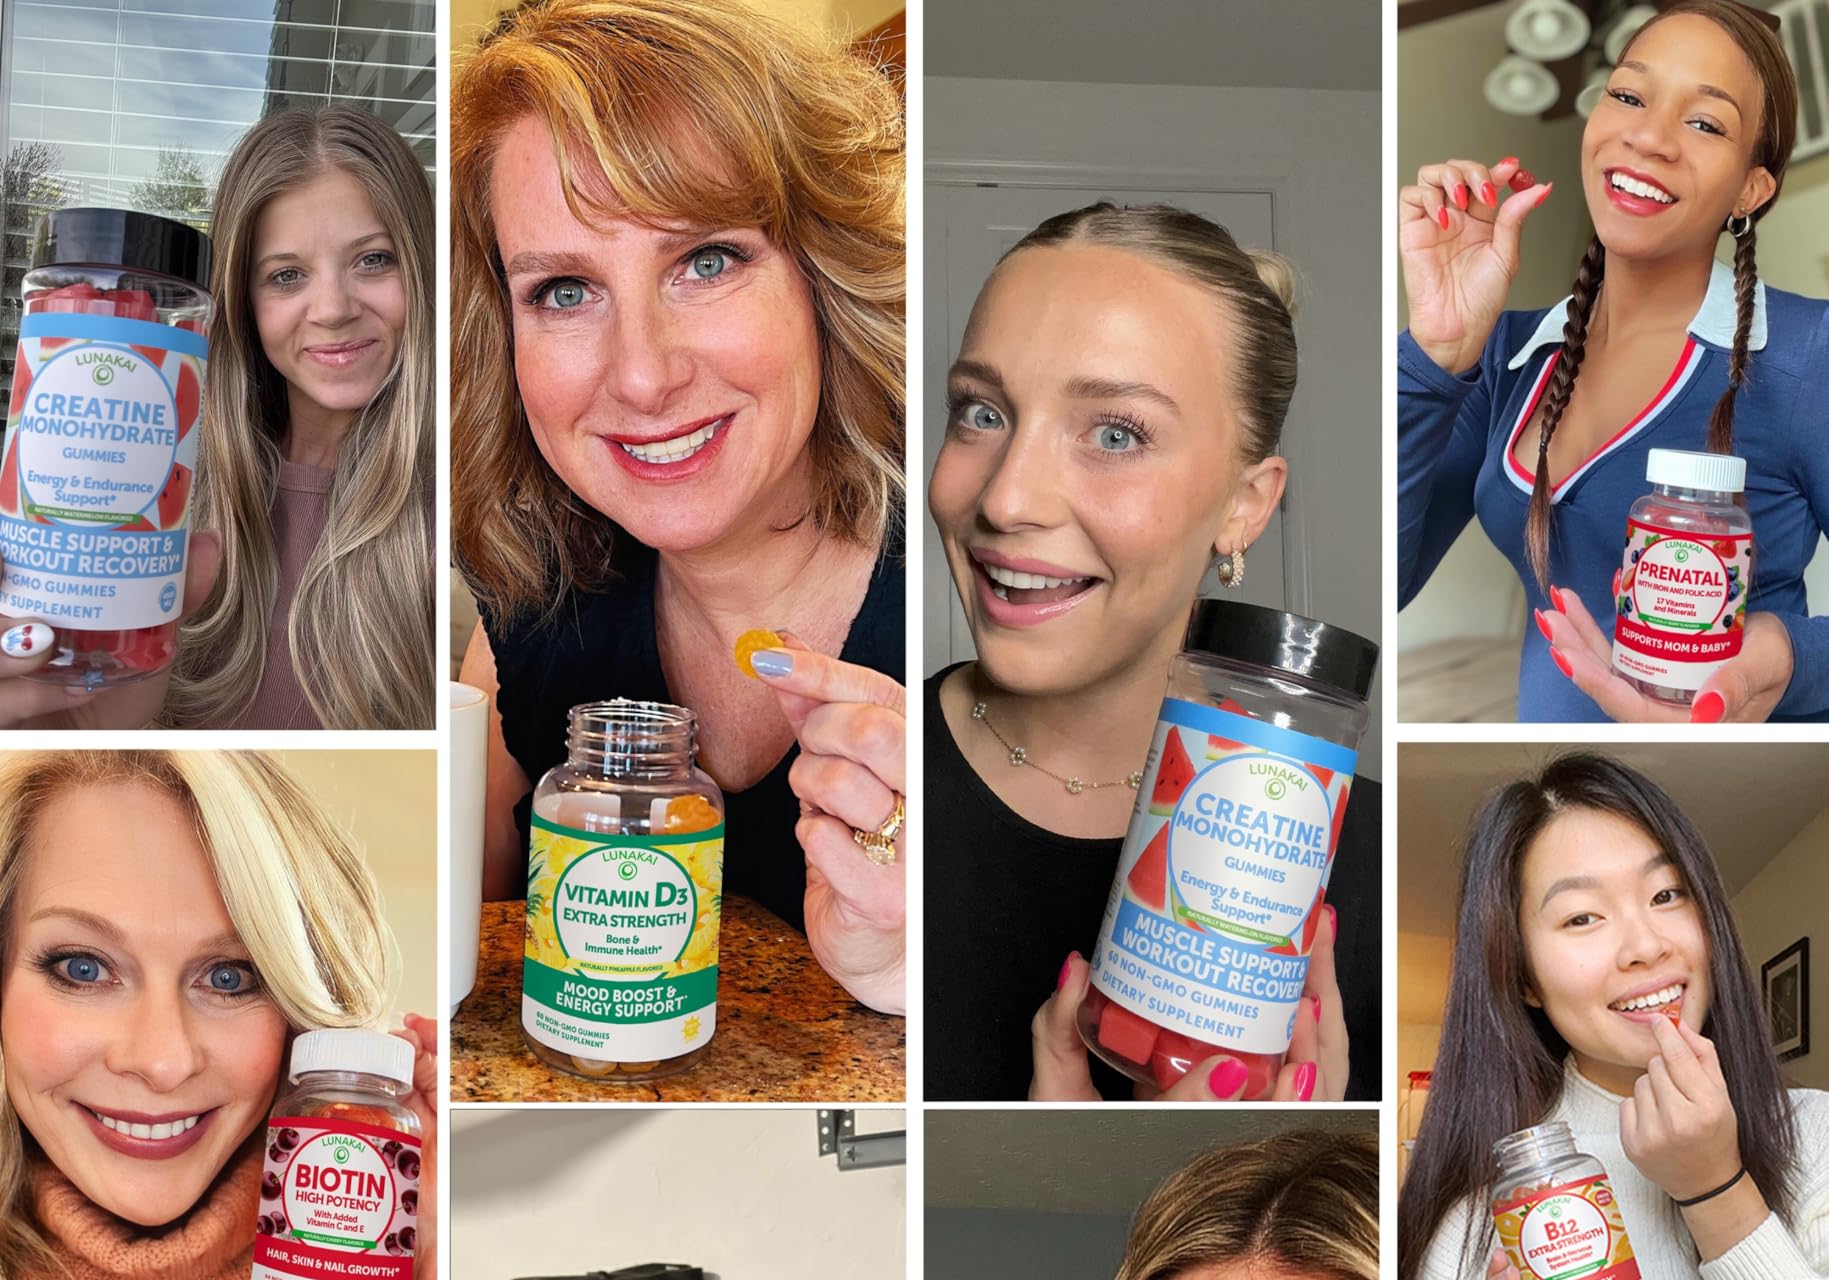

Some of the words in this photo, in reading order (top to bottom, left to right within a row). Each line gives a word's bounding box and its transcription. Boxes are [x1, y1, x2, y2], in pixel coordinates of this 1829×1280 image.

[75, 352, 137, 373] LUNAKAI
[34, 393, 165, 426] CREATINE
[22, 416, 174, 447] MONOHYDRATE
[62, 447, 126, 464] GUMMIES
[27, 470, 67, 488] Energy
[70, 477, 80, 487] &
[84, 479, 154, 493] Endurance
[34, 507, 64, 516] NATURALLY
[65, 512, 104, 520] WATERMELON
[105, 514, 133, 522] FLAVORED
[0, 540, 74, 572] ORKOUT
[66, 533, 161, 555] SUPPORT
[163, 537, 173, 550] &
[1665, 541, 1703, 553] LUNAKAI
[1640, 561, 1723, 586] PRENATAL
[45, 581, 117, 597] GUMMIES
[1638, 580, 1652, 589] WITH
[1653, 584, 1669, 593] IRON
[1669, 587, 1684, 595] AND
[11, 595, 103, 619] SUPPLEMENT
[1656, 597, 1665, 605] 17
[1665, 599, 1695, 609] Vitamins
[1667, 608, 1696, 616] Minerals
[1622, 627, 1663, 648] SUPPORTS
[1664, 639, 1691, 653] MOM
[1692, 644, 1699, 653] &
[1249, 763, 1308, 792] LUNAKAI
[1196, 793, 1324, 848] CREATINE
[1176, 811, 1326, 870] MONOHYDRATE
[602, 851, 658, 865] LUNAKAI
[1224, 856, 1287, 883] GUMMIES
[565, 883, 649, 908] VITAMIN
[655, 881, 688, 907] D3
[1180, 870, 1229, 899] Energy
[1230, 886, 1240, 899] &
[1242, 892, 1304, 917] Endurance
[563, 908, 608, 927] EXTRA
[610, 913, 687, 928] STRENGTH
[585, 943, 624, 955] Immune
[606, 935, 630, 945] Bone
[632, 936, 639, 944] &
[1135, 913, 1213, 959] MUSCLE
[1219, 946, 1299, 979] SUPPORT
[1122, 927, 1227, 984] WORKOUT
[563, 981, 609, 1000] MOOD
[612, 987, 664, 1002] BOOST
[666, 986, 677, 998] &
[1108, 950, 1119, 965] 60
[1120, 955, 1187, 998] NON-GMO
[1191, 988, 1259, 1019] GUMMIES
[556, 992, 612, 1017] ENERGY
[1102, 971, 1145, 1004] DIETARY
[1148, 996, 1245, 1039] SUPPLEMENT
[536, 1011, 544, 1019] 60
[545, 1015, 577, 1033] NON-GMO
[578, 1027, 610, 1040] GUMMIES
[536, 1019, 560, 1036] DIETARY
[561, 1032, 604, 1048] SUPPLEMENT
[322, 1136, 366, 1152] LUNAKAI
[295, 1164, 386, 1199] BIOTIN
[296, 1190, 324, 1205] HIGH
[326, 1194, 380, 1212] POTENCY
[307, 1217, 336, 1229] Vitamin
[343, 1223, 358, 1231] and
[359, 1225, 364, 1233] E
[314, 1209, 332, 1220] With
[333, 1212, 358, 1222] Added
[1544, 1219, 1580, 1242] B12
[1528, 1245, 1555, 1259] EXTRA
[1557, 1227, 1605, 1252] STRENGTH
[266, 1248, 290, 1263] HAIR,
[292, 1255, 314, 1267] SKIN
[315, 1260, 322, 1268] &
[324, 1262, 346, 1273] NAIL
